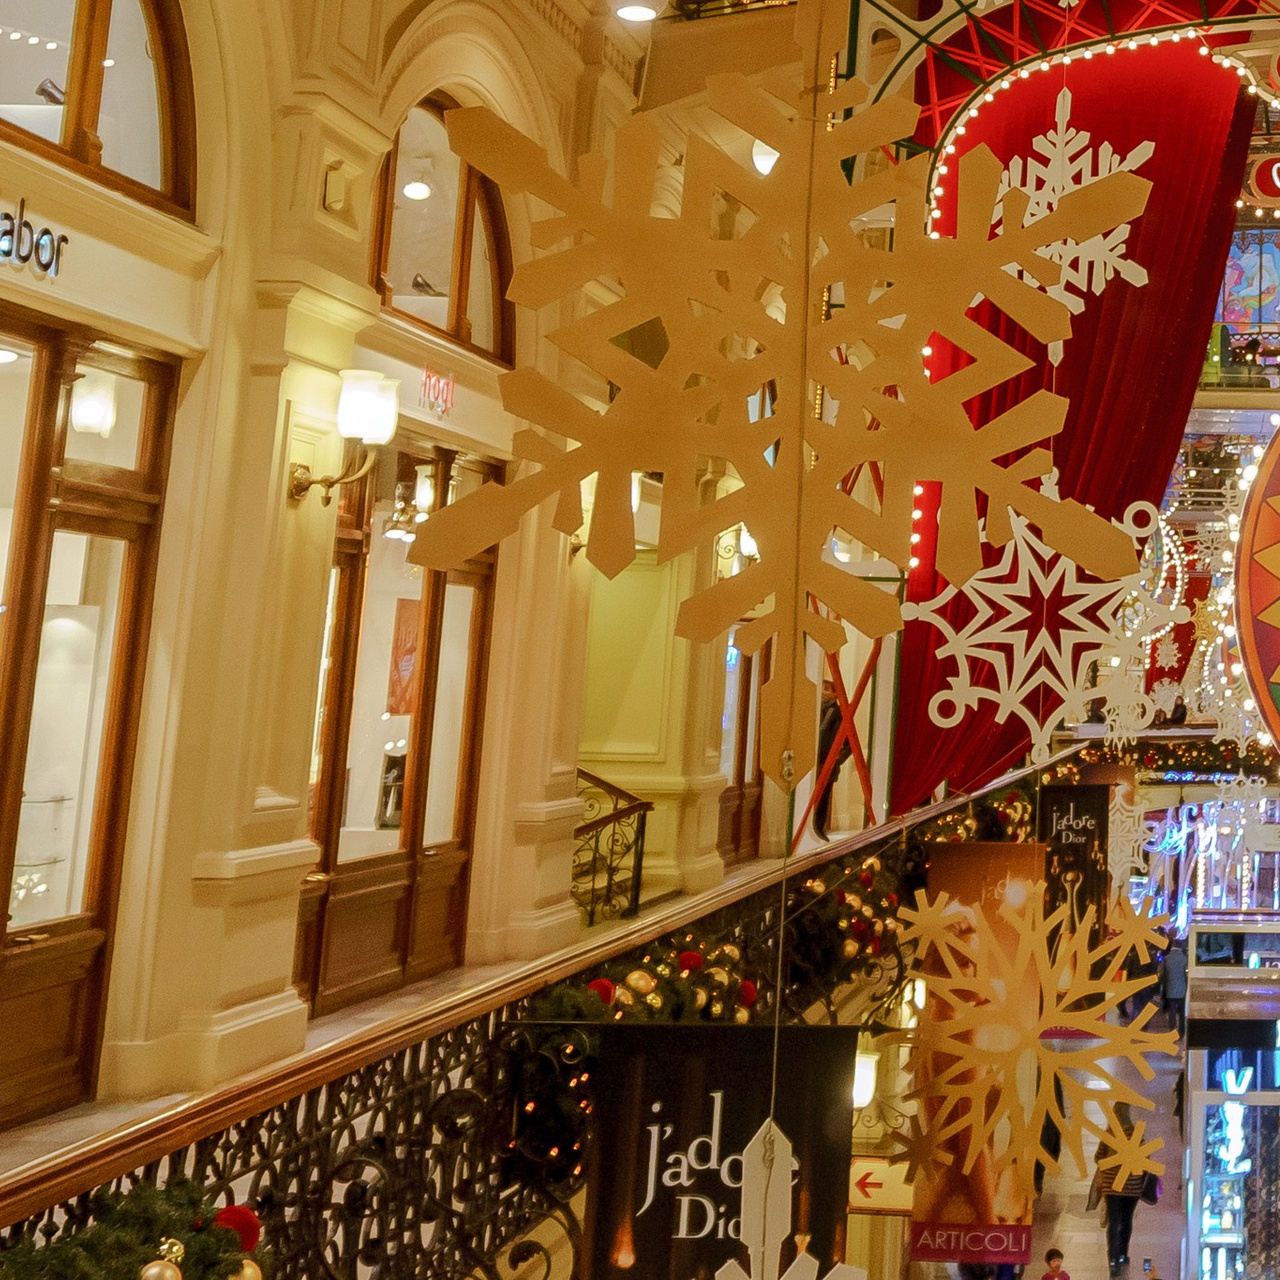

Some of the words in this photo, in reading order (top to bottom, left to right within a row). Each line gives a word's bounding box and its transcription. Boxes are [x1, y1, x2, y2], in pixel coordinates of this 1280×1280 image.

[1050, 802, 1096, 838] j'adore
[1062, 831, 1087, 844] Dior
[671, 1194, 743, 1240] Dio
[917, 1230, 1026, 1253] ARTICOLI
